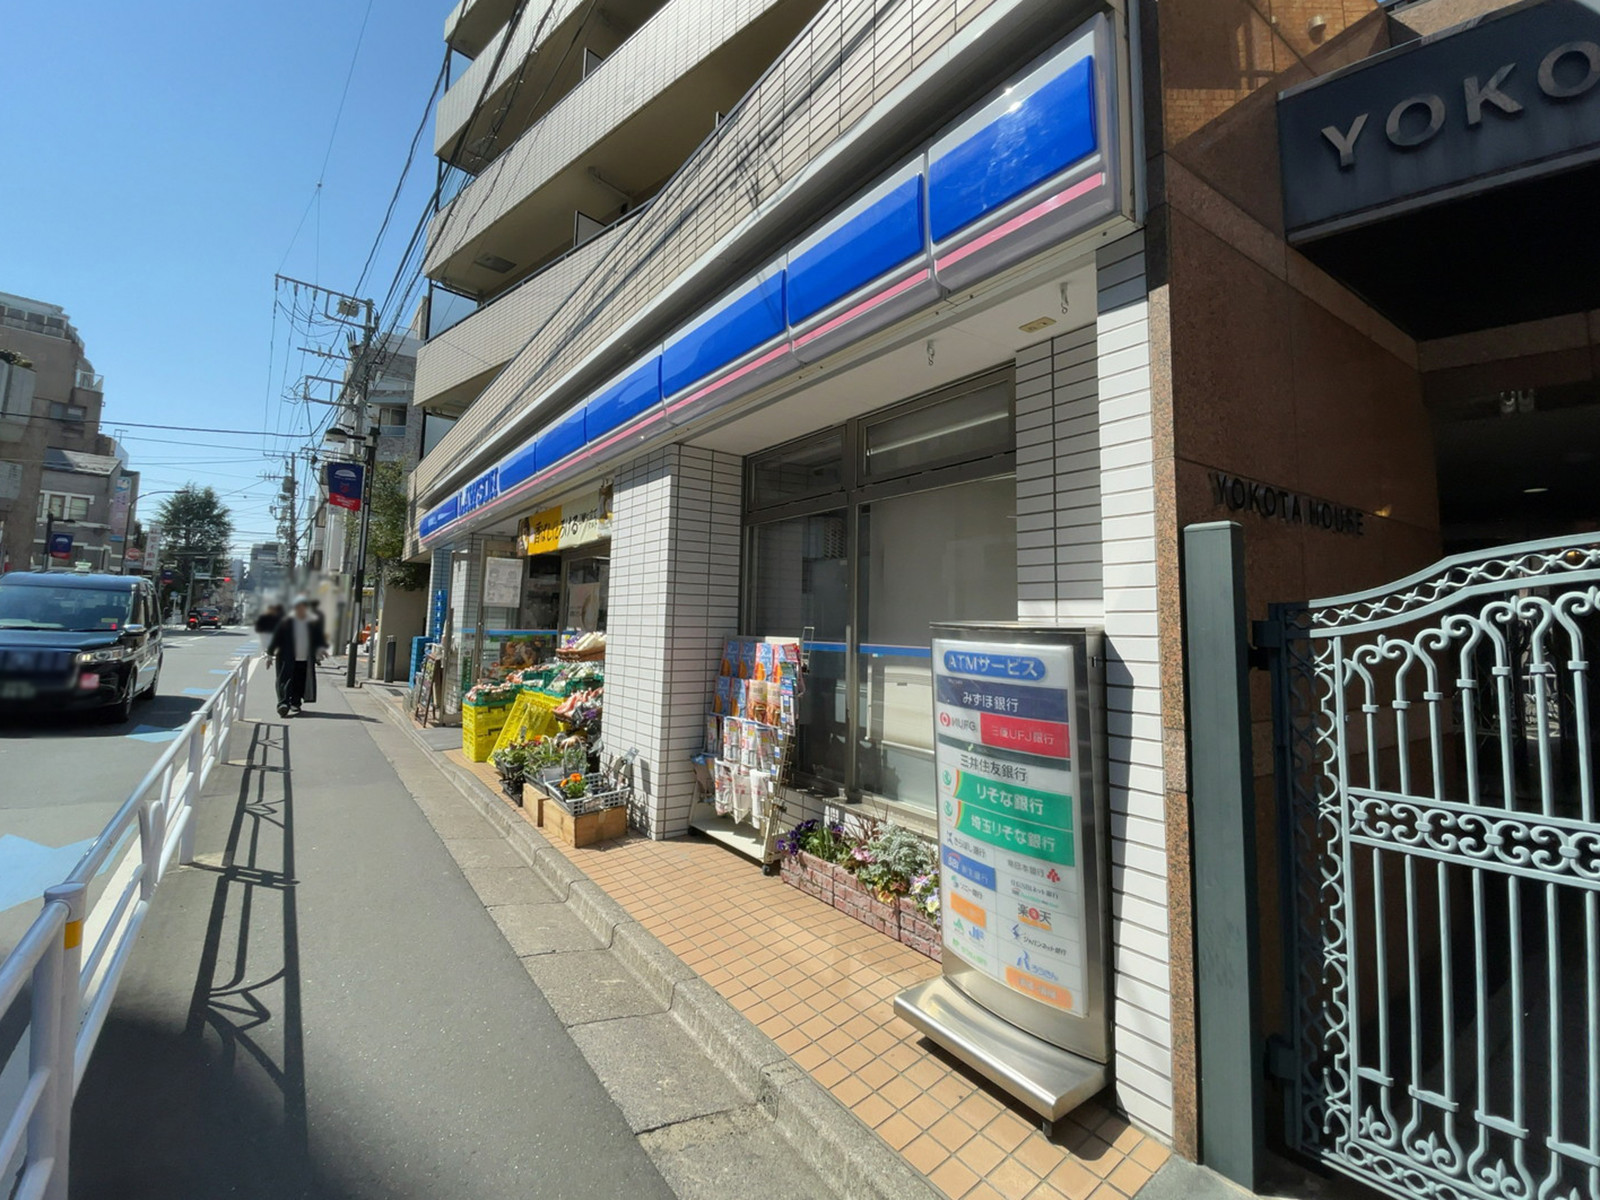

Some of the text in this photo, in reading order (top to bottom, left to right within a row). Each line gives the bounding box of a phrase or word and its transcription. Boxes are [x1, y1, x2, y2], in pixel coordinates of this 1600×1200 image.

[1208, 471, 1365, 536] YOKOTA HOUSE
[949, 655, 1037, 677] ATMサービス
[962, 691, 1019, 713] みずほ銀行
[960, 754, 1027, 782] 三井住友銀行
[976, 783, 1044, 815] りそな銀行
[970, 814, 1056, 852] 埼玉りそな銀行
